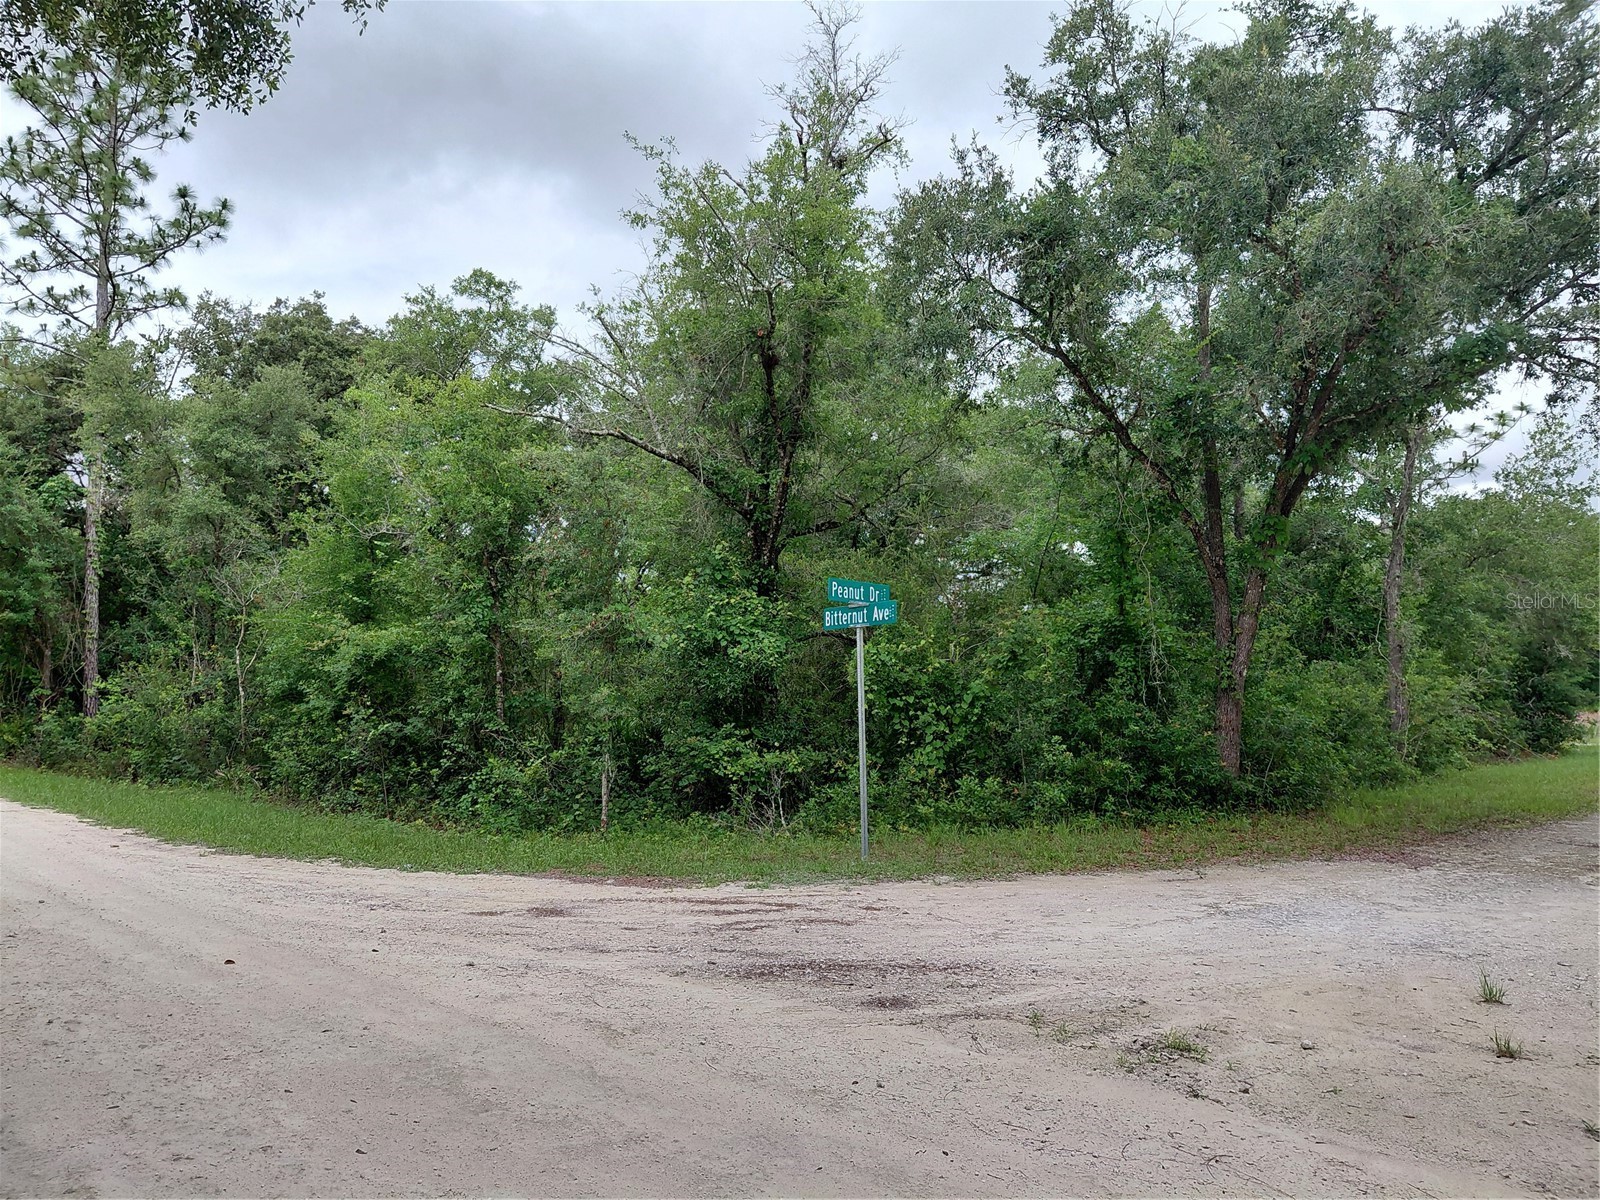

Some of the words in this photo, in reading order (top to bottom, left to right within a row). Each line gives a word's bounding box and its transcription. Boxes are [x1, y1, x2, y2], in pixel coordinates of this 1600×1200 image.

[831, 581, 865, 601] Peanut
[869, 586, 880, 602] Dr
[825, 607, 868, 627] Bitternut
[872, 605, 889, 622] Ave
